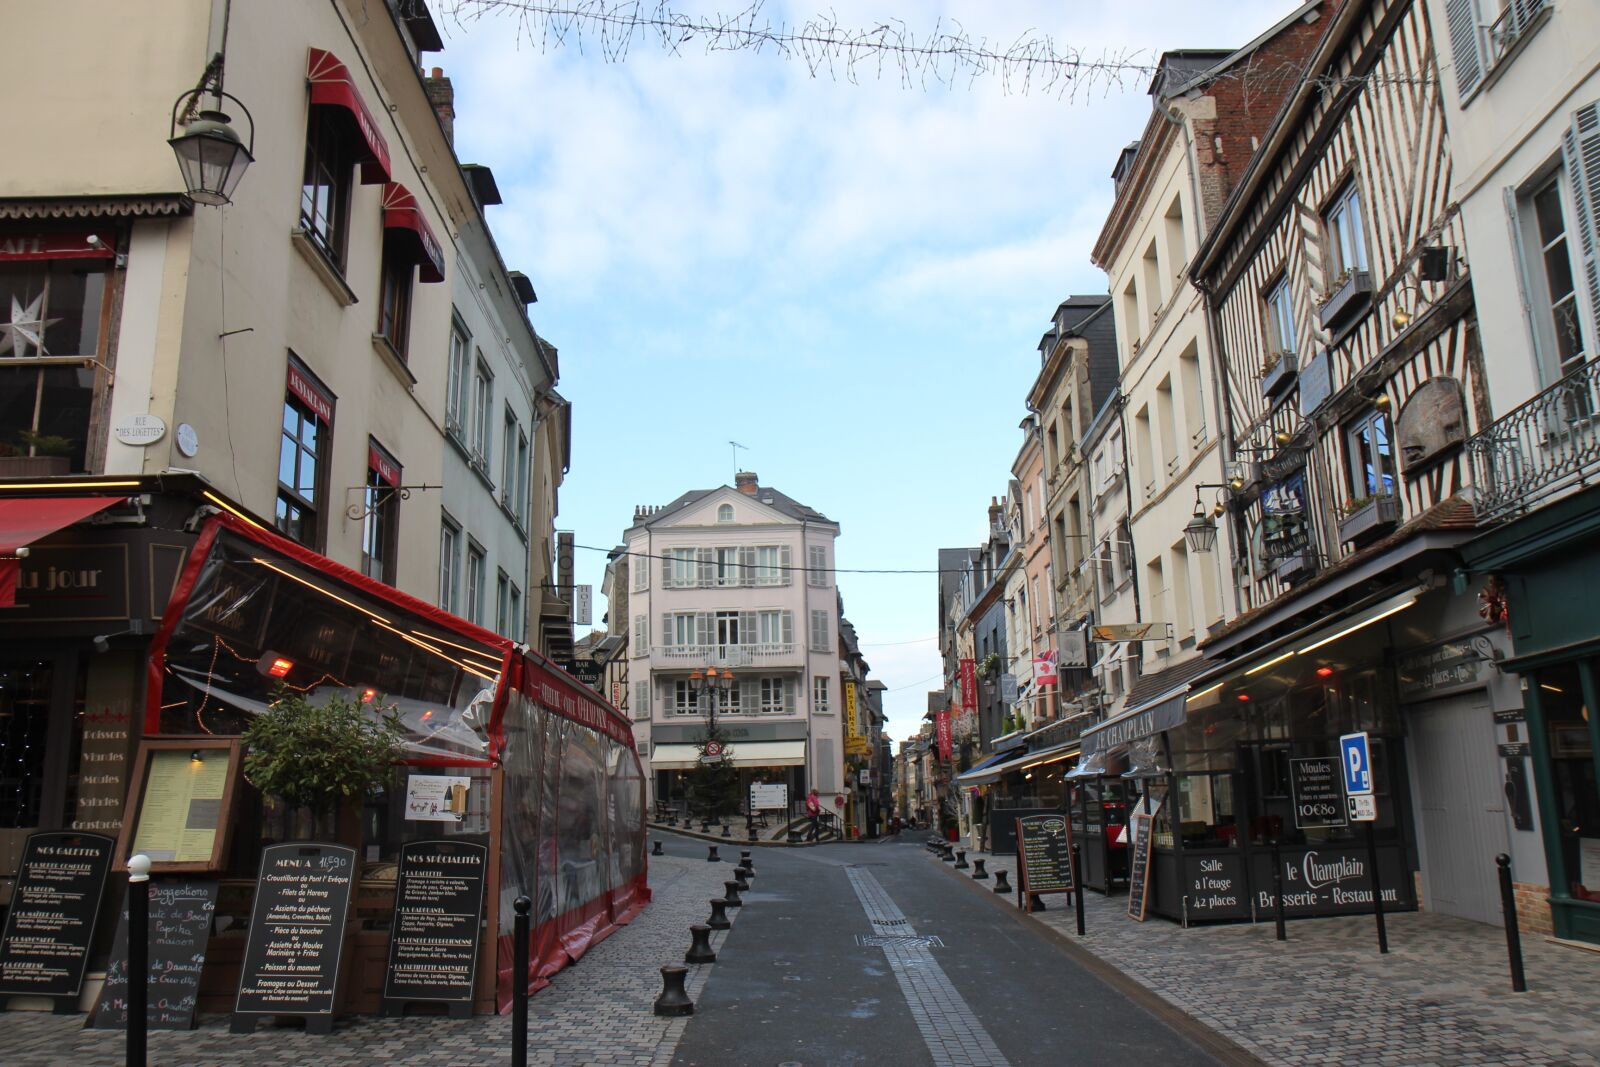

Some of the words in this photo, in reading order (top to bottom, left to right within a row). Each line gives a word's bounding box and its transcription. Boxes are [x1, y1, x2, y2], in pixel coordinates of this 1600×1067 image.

[46, 566, 103, 591] jour
[580, 586, 588, 623] HOTEL
[83, 730, 128, 740] Poissons
[1096, 732, 1106, 749] LE
[1107, 711, 1154, 746] CHAMPLAIN
[1300, 762, 1331, 774] Moules
[1349, 746, 1361, 782] P
[1298, 804, 1336, 816] 10€80
[56, 848, 100, 856] GALETTES
[275, 859, 302, 868] MENU
[407, 855, 423, 863] NOS
[426, 854, 480, 864] SPÉCIALITÉS
[1199, 860, 1222, 872] Salle
[1286, 862, 1297, 880] le
[1302, 851, 1364, 889] Champlain
[266, 874, 300, 882] Croustillant
[308, 875, 322, 883] Pont
[148, 884, 208, 905] Suggestions
[306, 890, 328, 898] Hareng
[1258, 891, 1317, 908] Brsserie
[1333, 887, 1398, 904] Restauant
[1192, 897, 1206, 909] 42
[1208, 894, 1236, 909] places
[156, 920, 193, 938] Paprika
[274, 926, 289, 934] Pièce
[290, 926, 298, 934] du
[302, 942, 323, 950] Moules
[257, 979, 286, 989] Fromages
